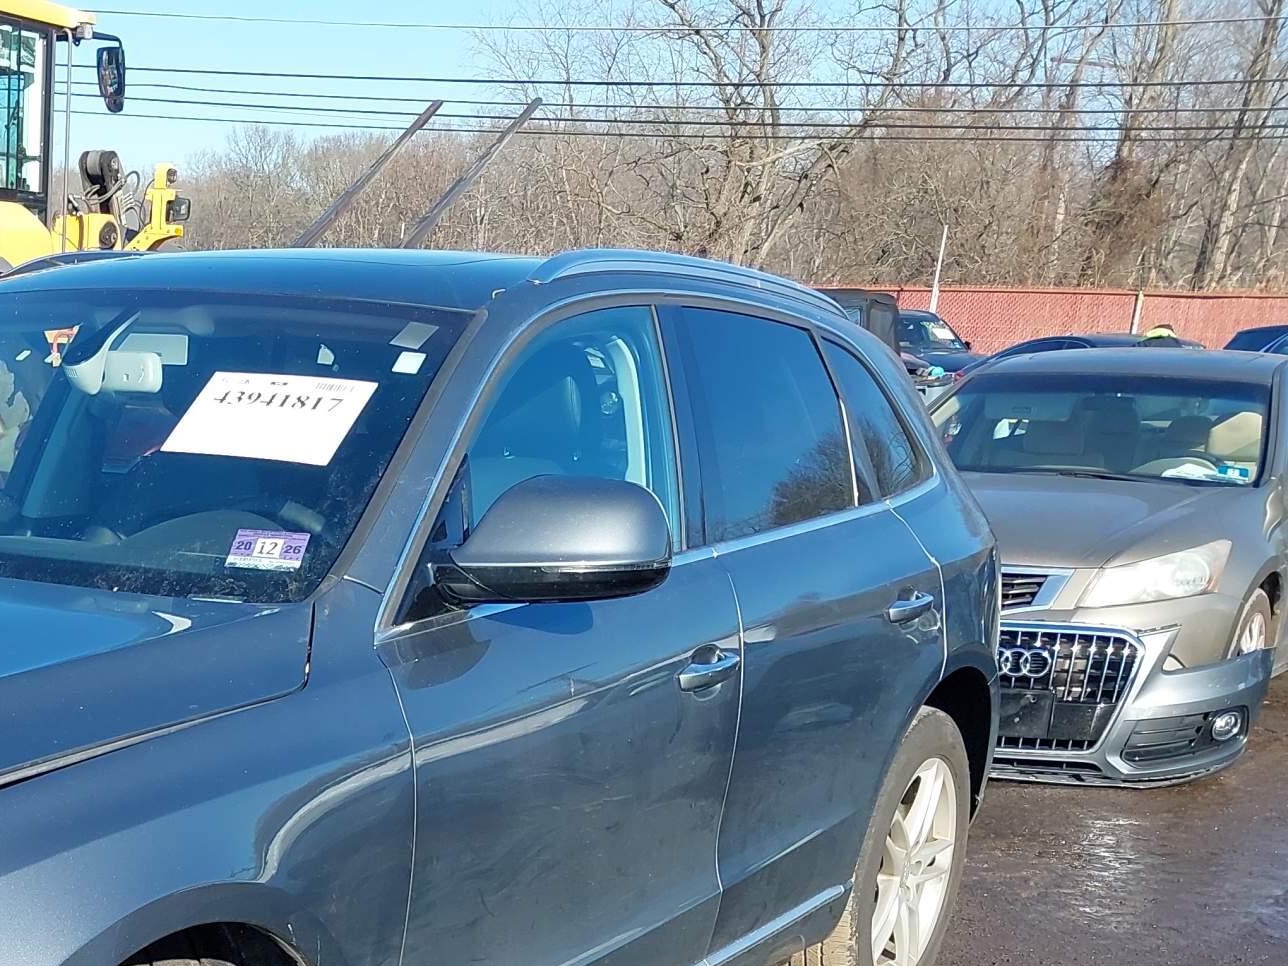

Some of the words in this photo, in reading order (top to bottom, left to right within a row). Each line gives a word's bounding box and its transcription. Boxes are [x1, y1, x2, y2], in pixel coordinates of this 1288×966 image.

[213, 390, 344, 412] 43941817
[235, 541, 252, 551] 20
[257, 541, 278, 555] 12
[283, 545, 302, 555] 26
